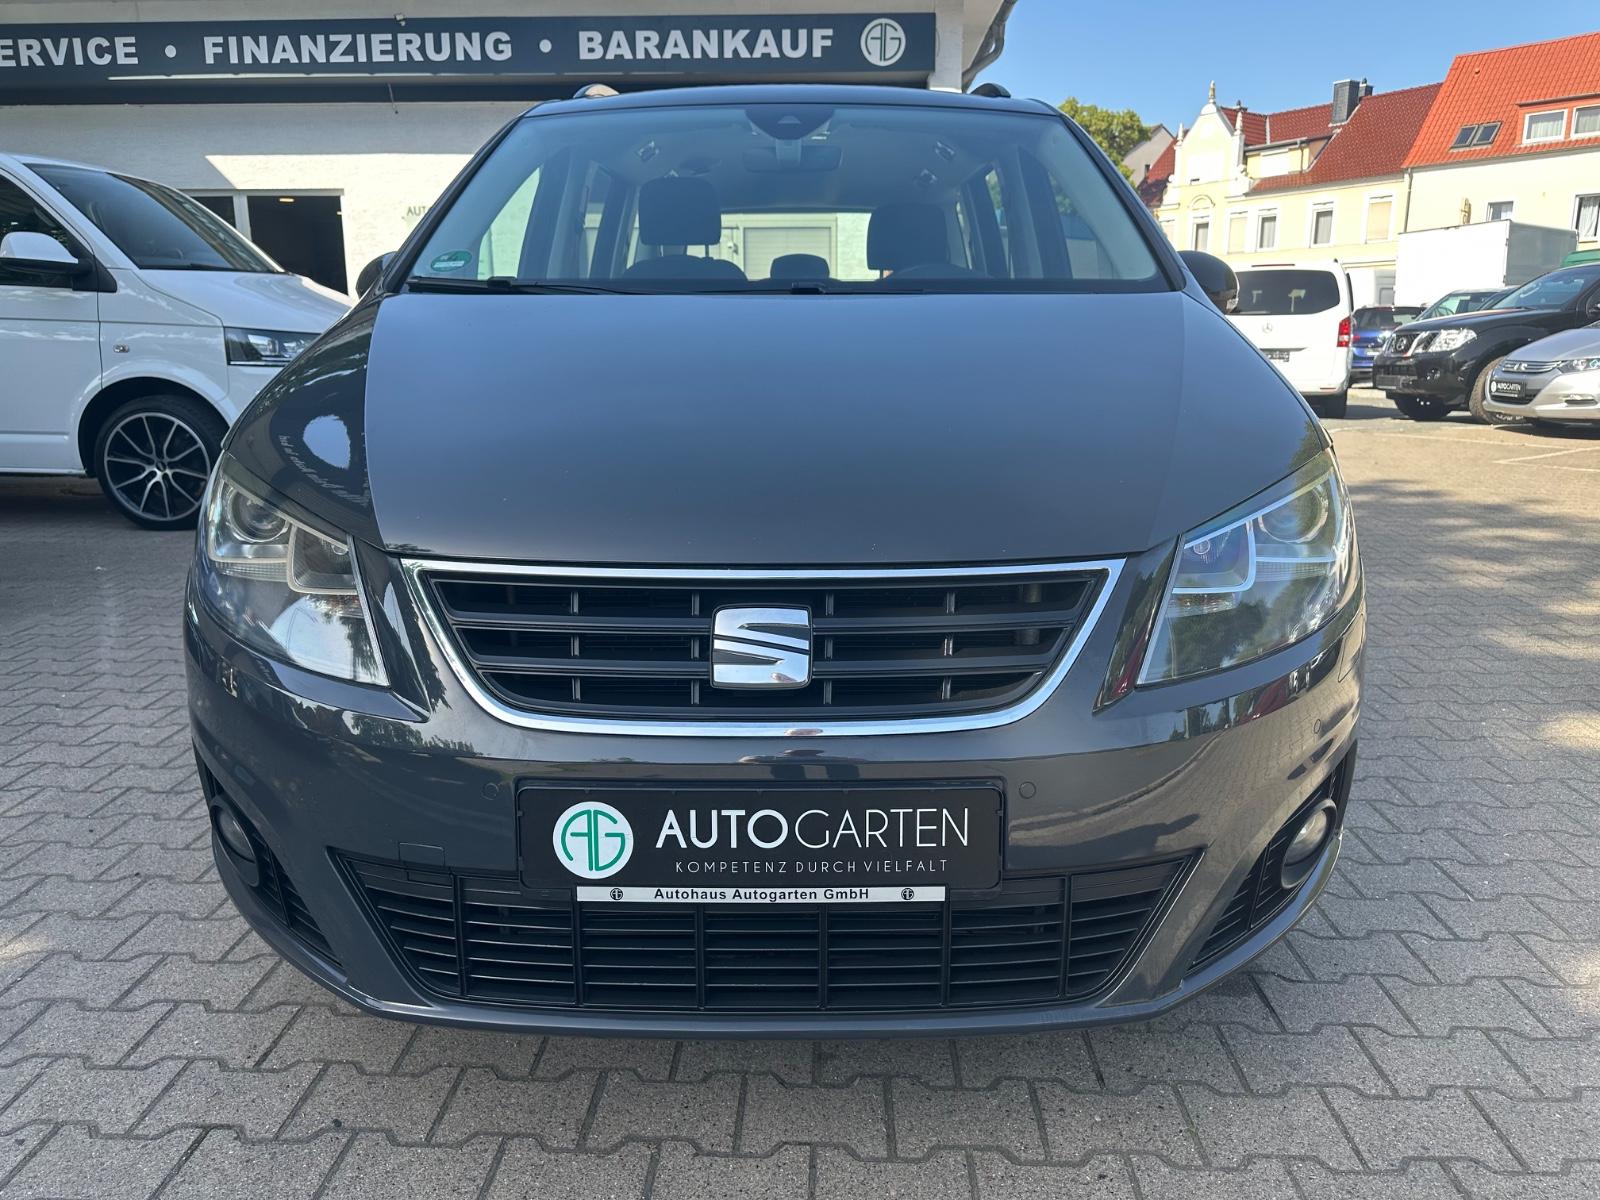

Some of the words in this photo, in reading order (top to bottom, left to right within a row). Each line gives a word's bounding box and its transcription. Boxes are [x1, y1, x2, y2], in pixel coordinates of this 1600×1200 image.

[203, 31, 513, 65] FINANZIERUNG
[578, 28, 834, 60] BARANKAUF
[655, 808, 969, 849] AUTOGARTEN
[675, 860, 788, 873] KOMPETENZ
[796, 860, 856, 873] DURCH
[863, 859, 948, 873] VIELFALT
[654, 888, 727, 900] Autohaus
[732, 888, 818, 902] Autogarten
[823, 888, 869, 899] GmbH
